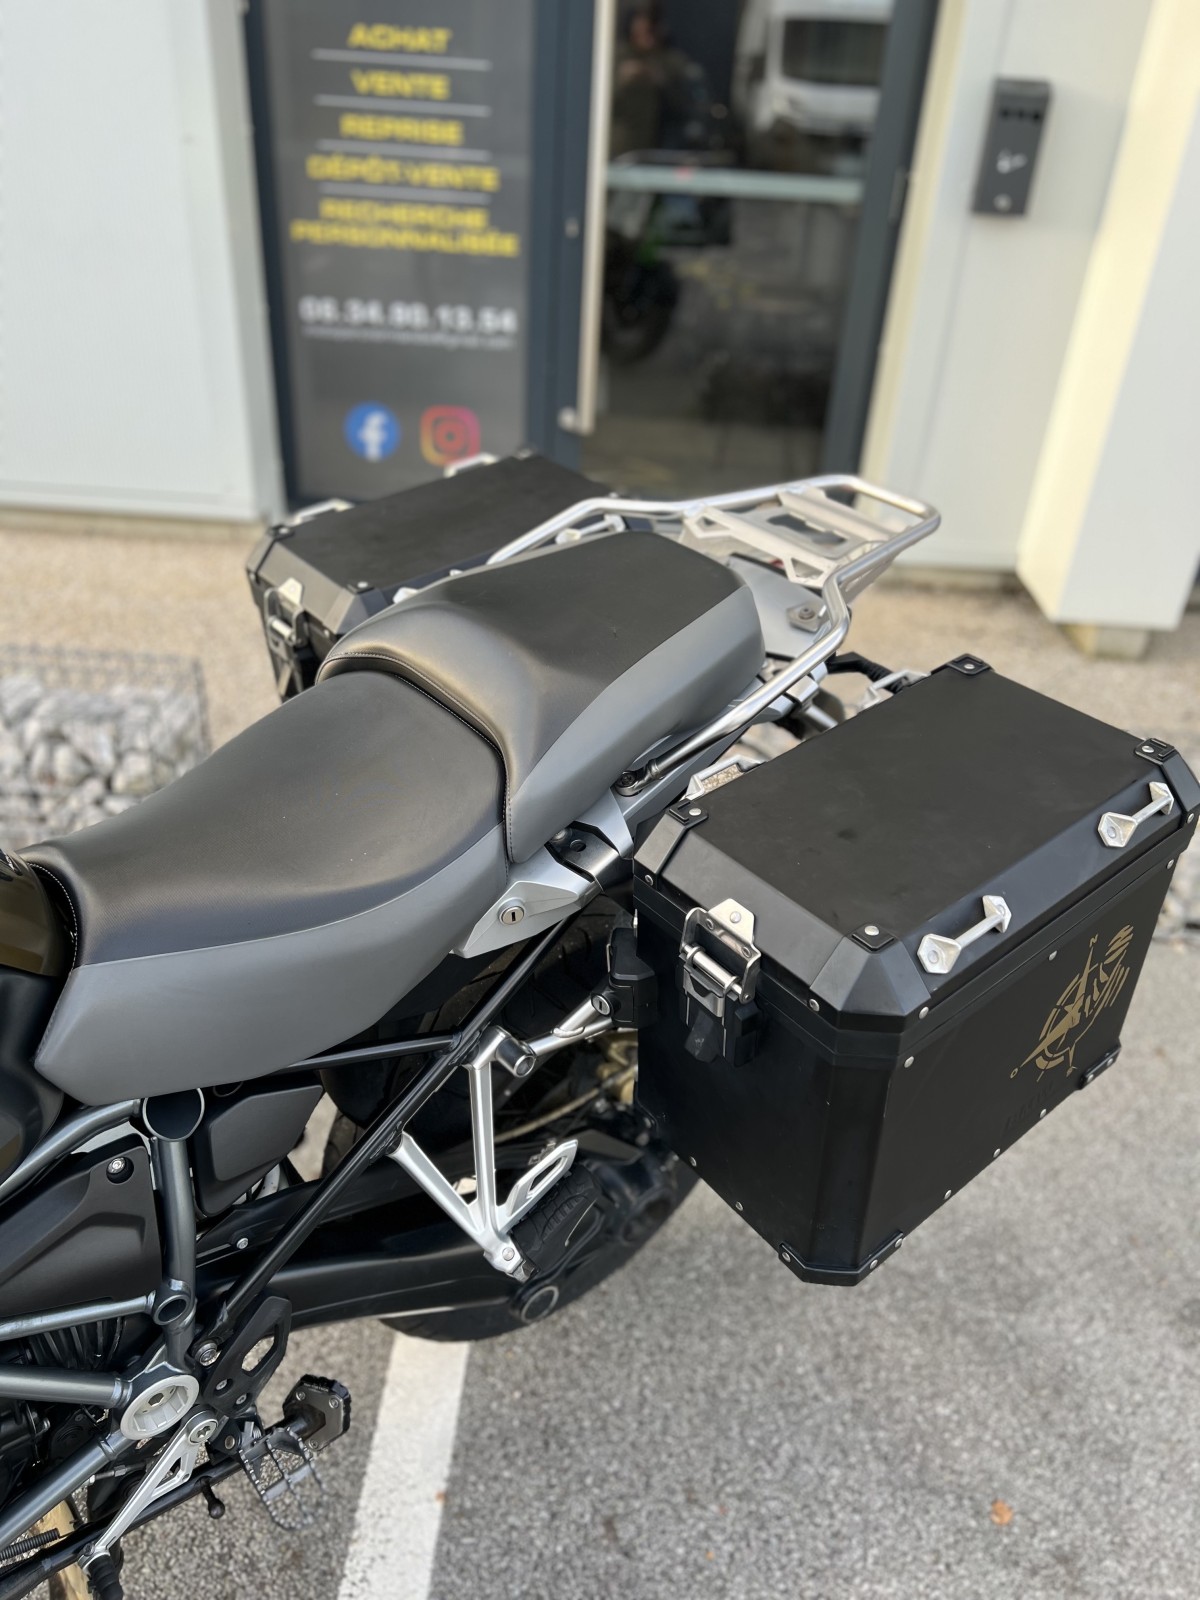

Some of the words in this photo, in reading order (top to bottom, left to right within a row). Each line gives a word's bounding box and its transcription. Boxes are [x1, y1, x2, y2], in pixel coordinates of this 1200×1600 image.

[349, 23, 451, 52] ACHAT
[351, 70, 449, 98] VENTE
[340, 113, 463, 145] REPRISE
[319, 199, 488, 229] RECHERCHE
[291, 220, 518, 257] PERSONNALISÉE
